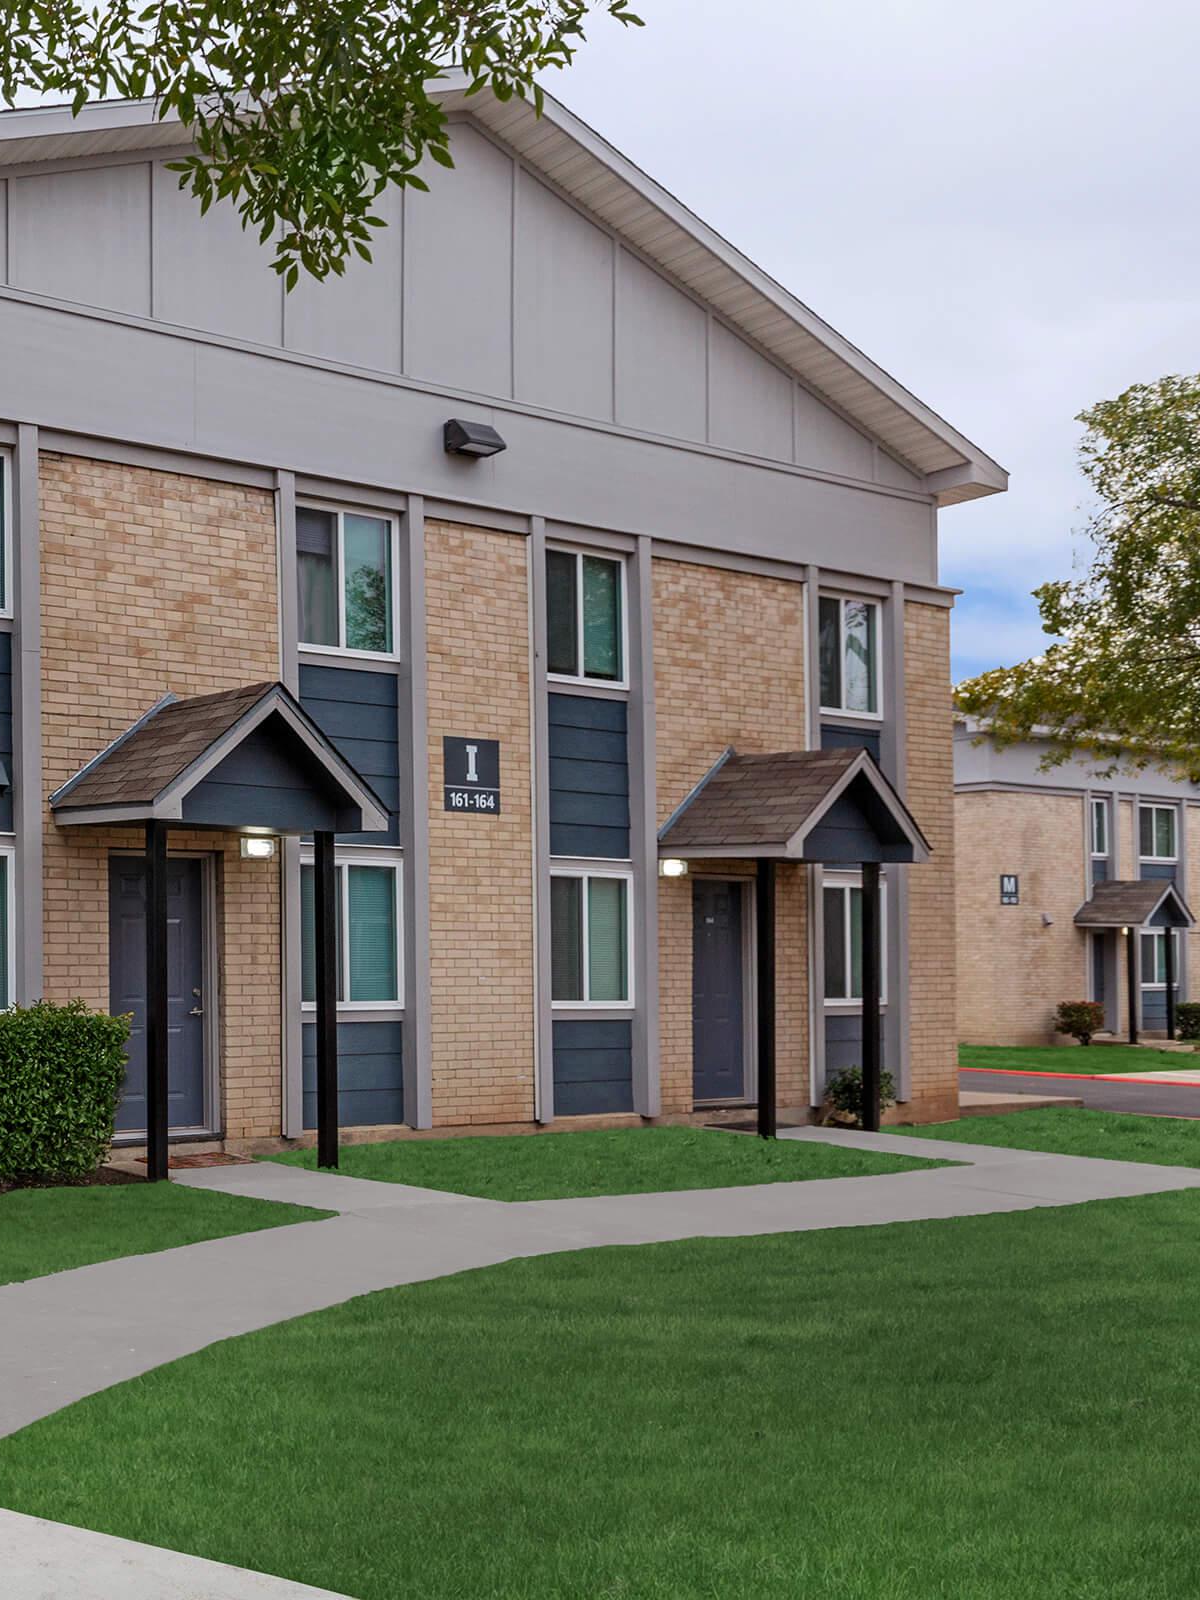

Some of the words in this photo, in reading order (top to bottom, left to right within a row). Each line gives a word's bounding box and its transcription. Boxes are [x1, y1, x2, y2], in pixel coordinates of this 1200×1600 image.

[466, 745, 478, 781] I
[450, 792, 495, 809] 161-164
[1003, 876, 1016, 893] M
